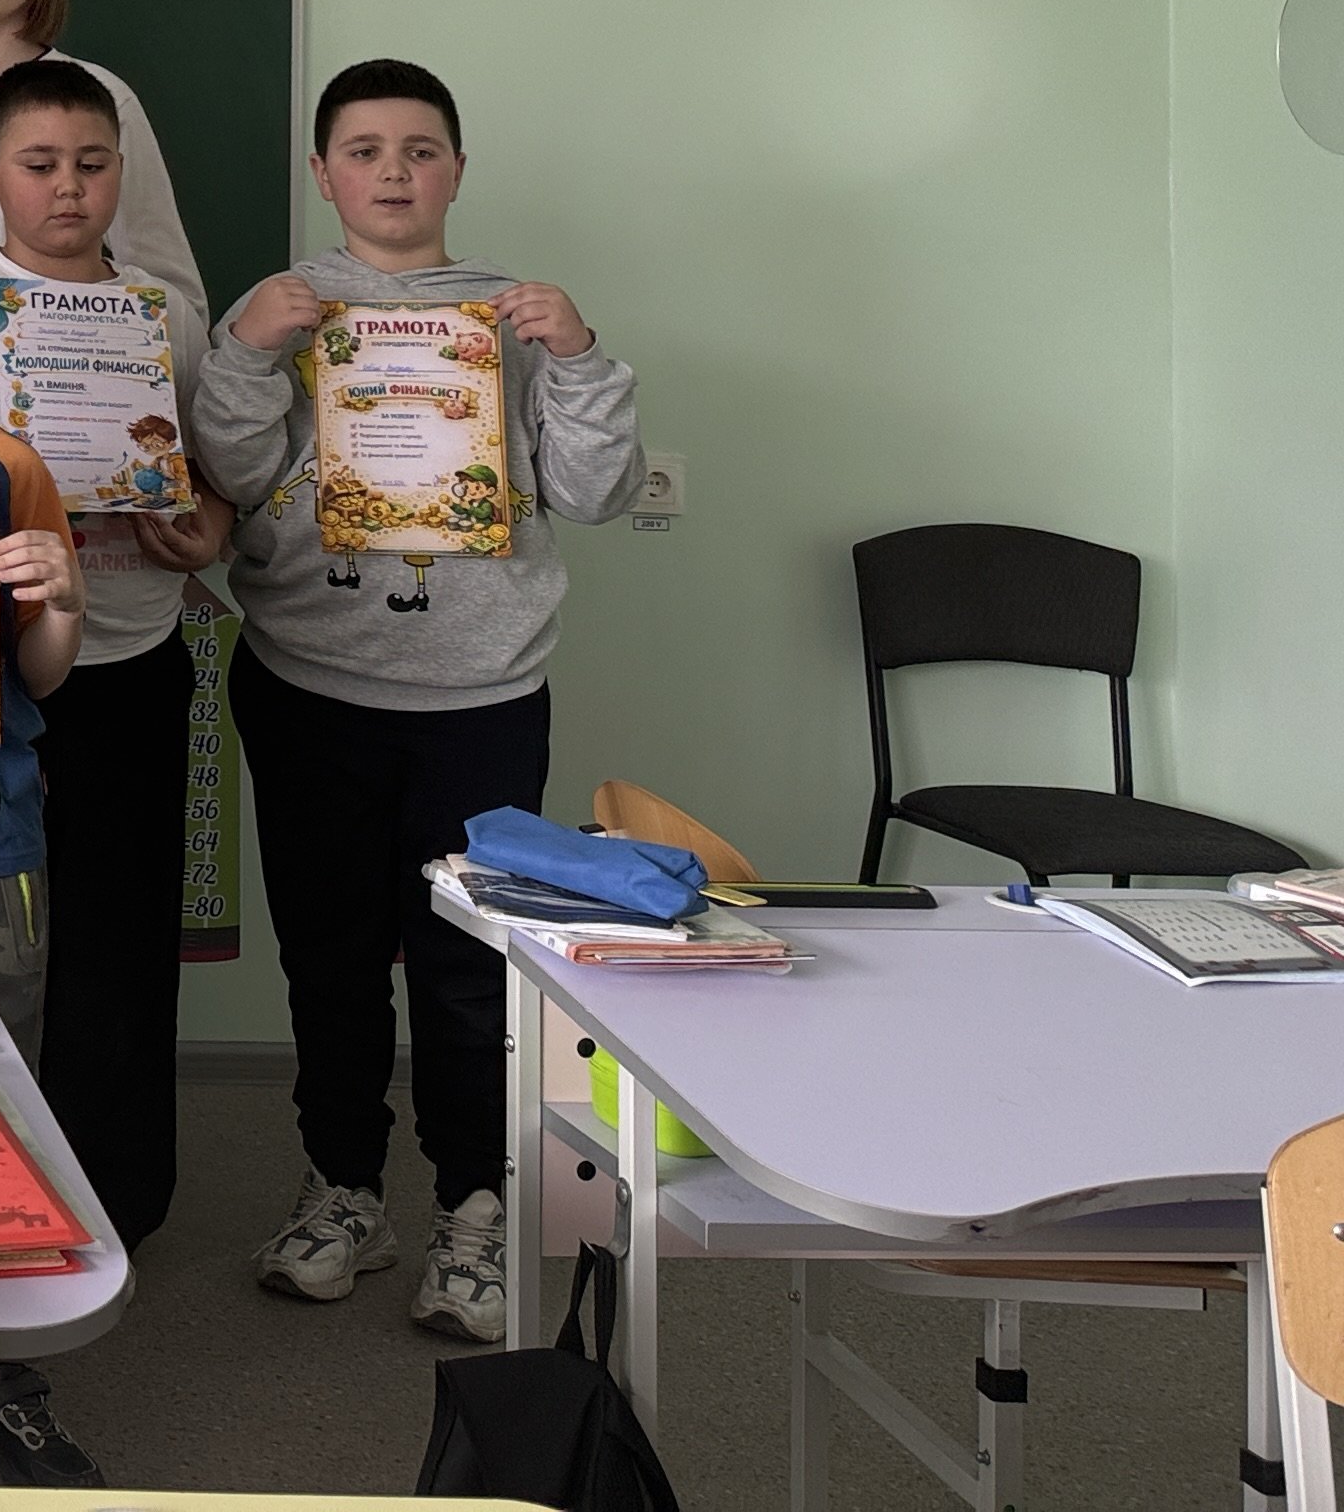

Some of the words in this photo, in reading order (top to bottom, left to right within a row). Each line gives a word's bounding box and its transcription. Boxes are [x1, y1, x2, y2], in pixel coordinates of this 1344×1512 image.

[30, 291, 136, 316] ГРАМОТА
[355, 320, 450, 337] ГРАМОТА
[15, 356, 90, 372] МОЛОДШИЙ
[93, 359, 161, 378] ФІНАНСИСТ
[348, 382, 387, 399] ЮНИЙ
[389, 384, 462, 400] ФІНАНСИСТ
[185, 605, 210, 625] =8
[182, 896, 224, 917] =80
